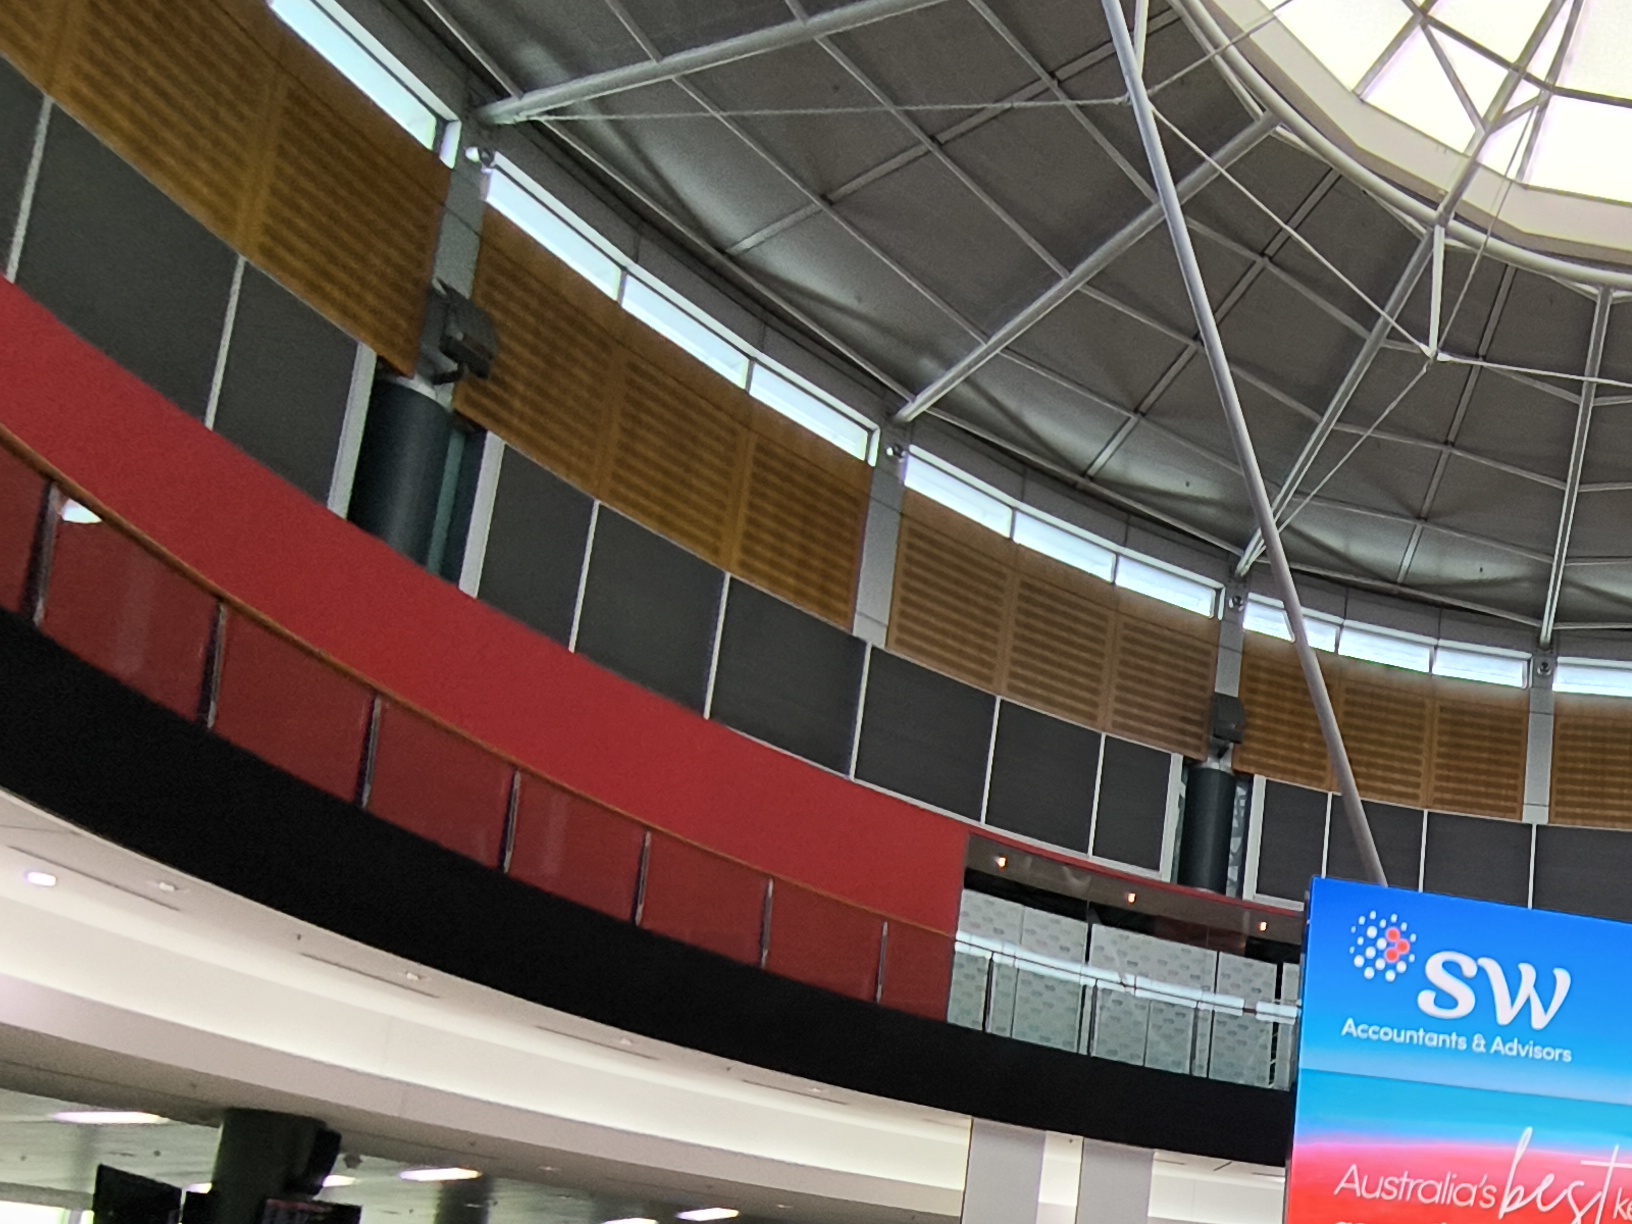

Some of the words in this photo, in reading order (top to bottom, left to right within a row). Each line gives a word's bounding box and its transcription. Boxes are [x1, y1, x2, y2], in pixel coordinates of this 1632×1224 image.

[1417, 950, 1571, 1031] SW
[1341, 1017, 1467, 1051] Accountants
[1471, 1033, 1487, 1053] &
[1490, 1036, 1573, 1063] Advisors
[1334, 1164, 1498, 1209] Australia's
